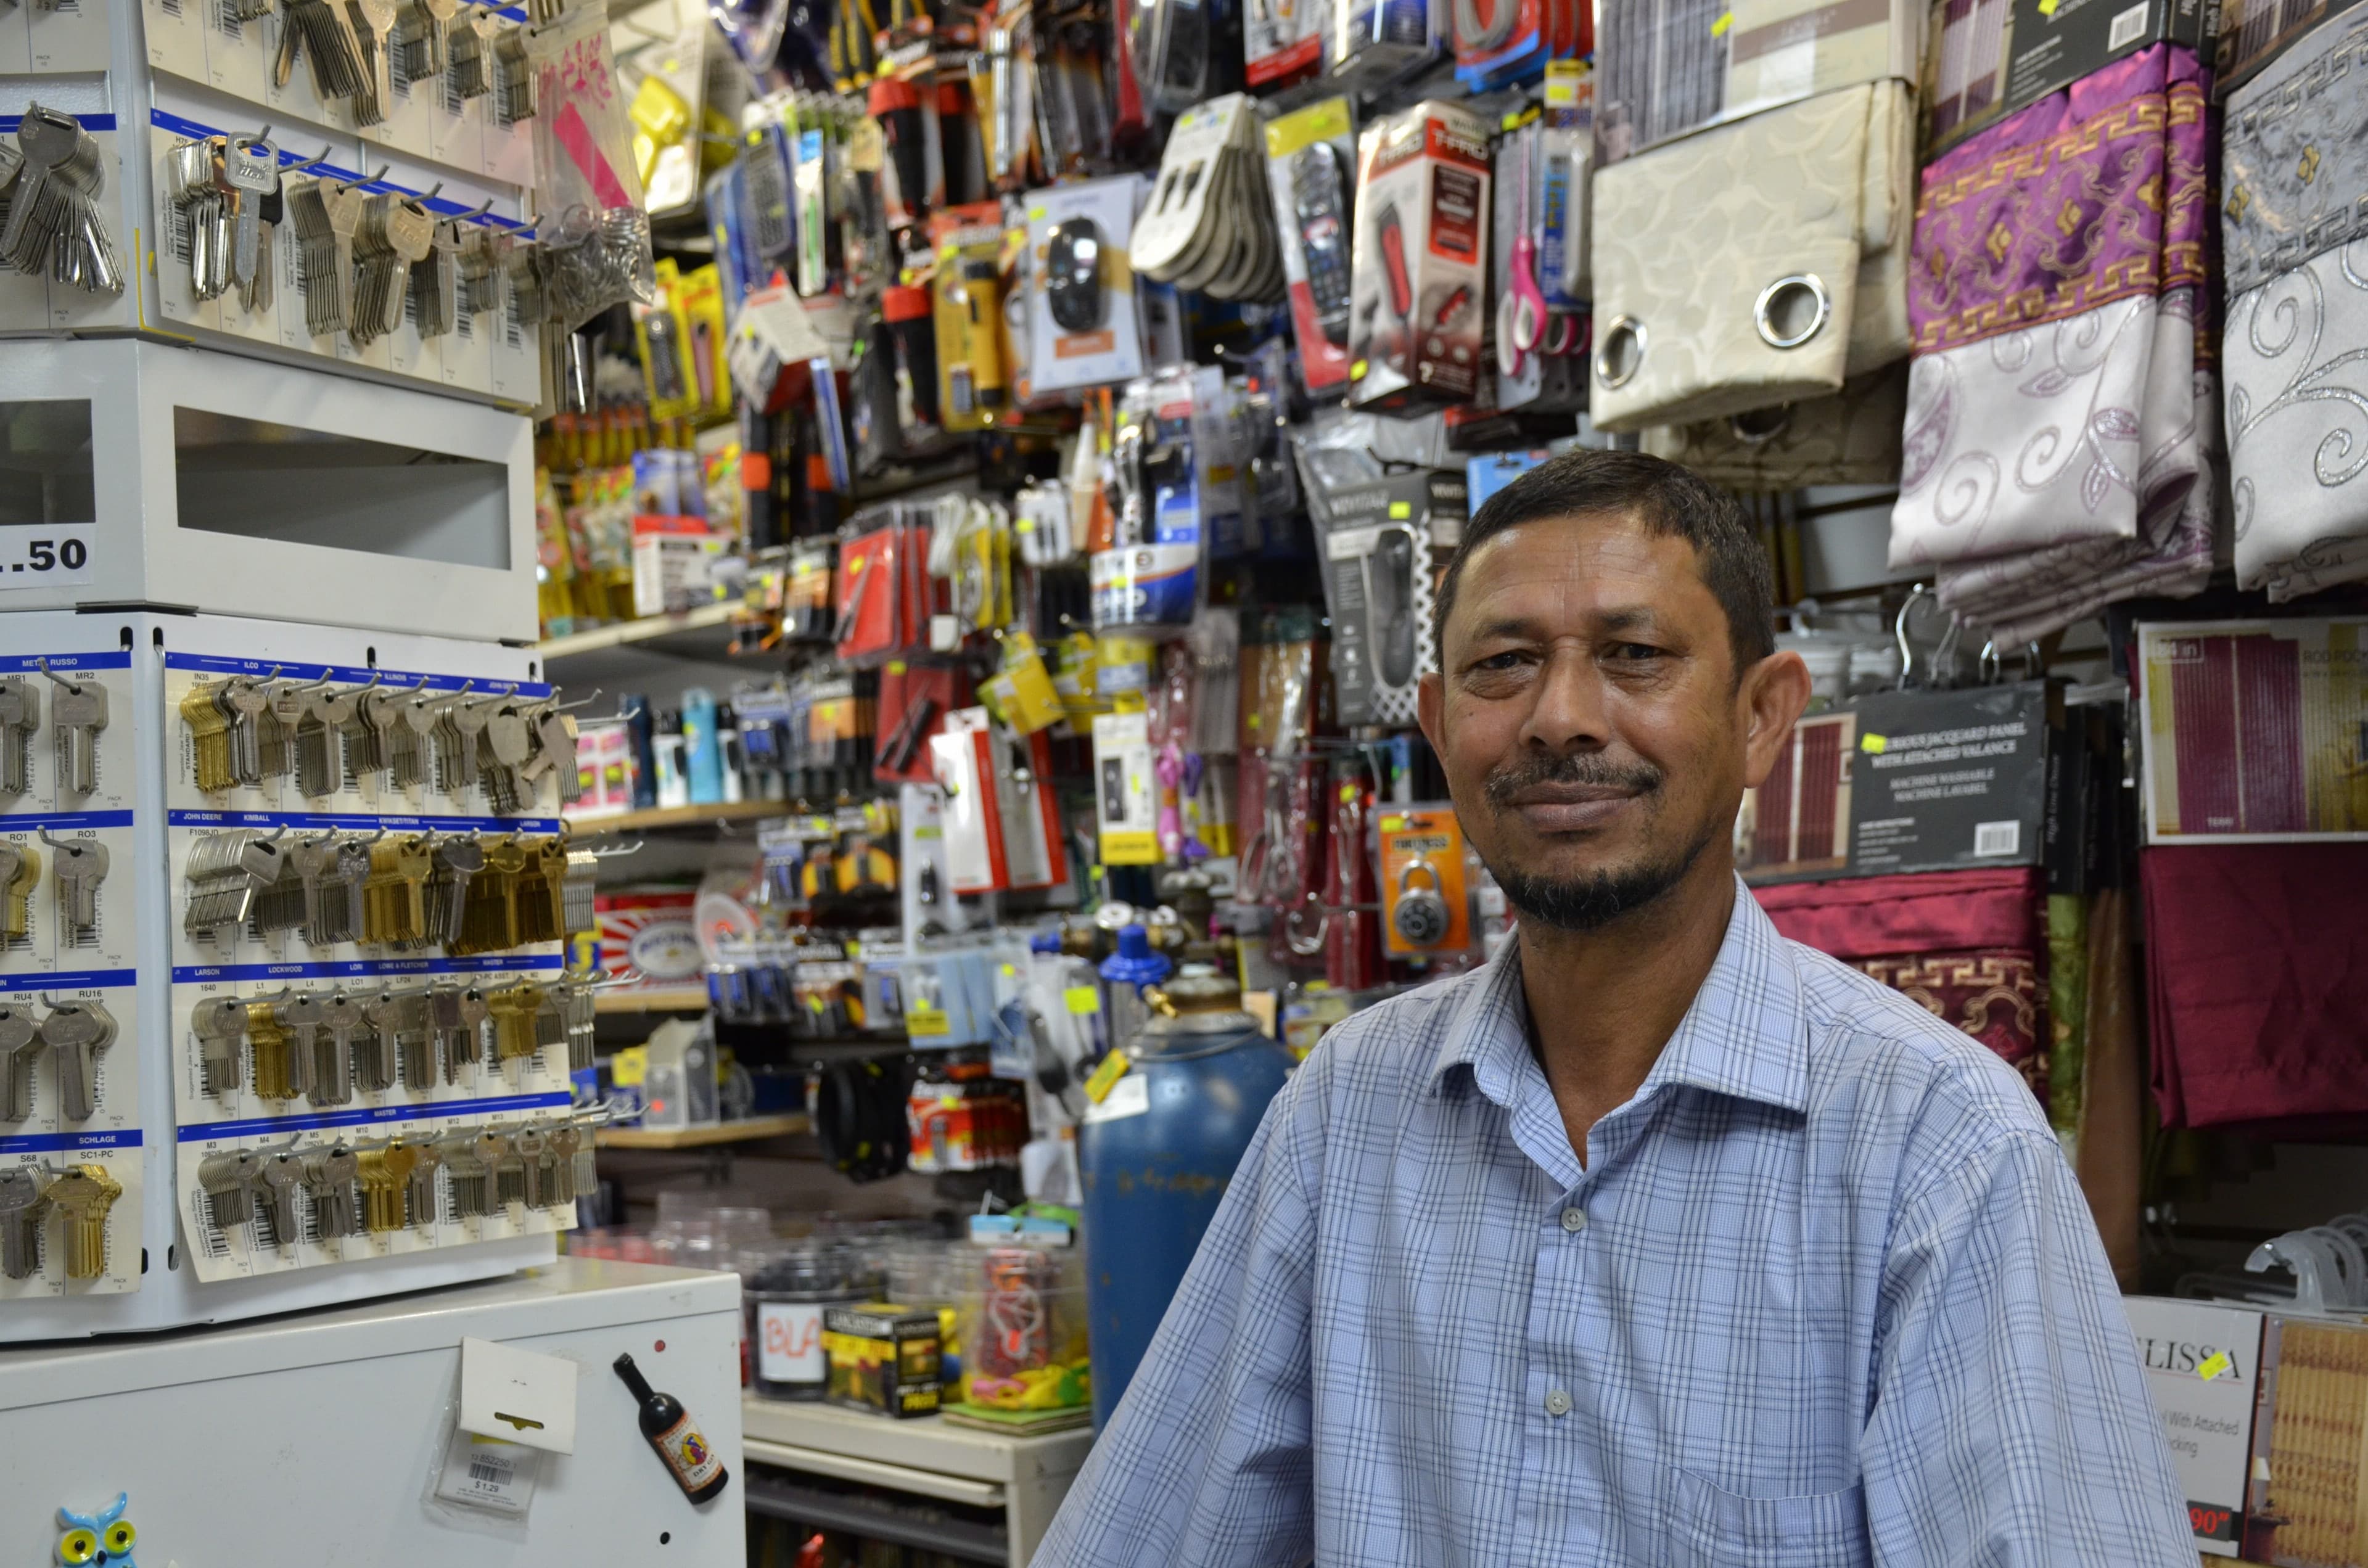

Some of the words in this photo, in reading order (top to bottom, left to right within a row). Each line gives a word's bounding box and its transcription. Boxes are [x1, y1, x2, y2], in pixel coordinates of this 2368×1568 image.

[0, 538, 87, 573] .50
[194, 673, 209, 681] IN35
[384, 673, 407, 681] ILLINOIS
[1925, 726, 1988, 748] JACQUARD
[1988, 721, 2028, 739] PANEL
[1871, 752, 1904, 769] WITH
[1904, 745, 1962, 764] ATTACHED
[1962, 739, 2017, 758] VALANCE
[1889, 773, 1938, 790] MACHINE
[1938, 766, 1996, 784] WASHABLE
[1894, 785, 1942, 802] MACHINE
[401, 961, 429, 969] FLETCHER
[268, 966, 303, 974] LOCKWOOD
[396, 976, 411, 984] LF24
[374, 1109, 397, 1117] MASTER
[447, 1117, 459, 1125] M12
[402, 1122, 414, 1130] M11
[310, 1131, 319, 1139] M5
[79, 1136, 117, 1144] SCHLAGE
[207, 1141, 217, 1149] M3
[80, 1151, 113, 1159] SC1-PC
[197, 1189, 206, 1225] STANDARD
[2137, 1337, 2243, 1379] LISSA
[2169, 1410, 2192, 1427] With
[2192, 1414, 2241, 1437] Attached
[475, 1480, 481, 1489] $
[483, 1483, 499, 1493] 1.29
